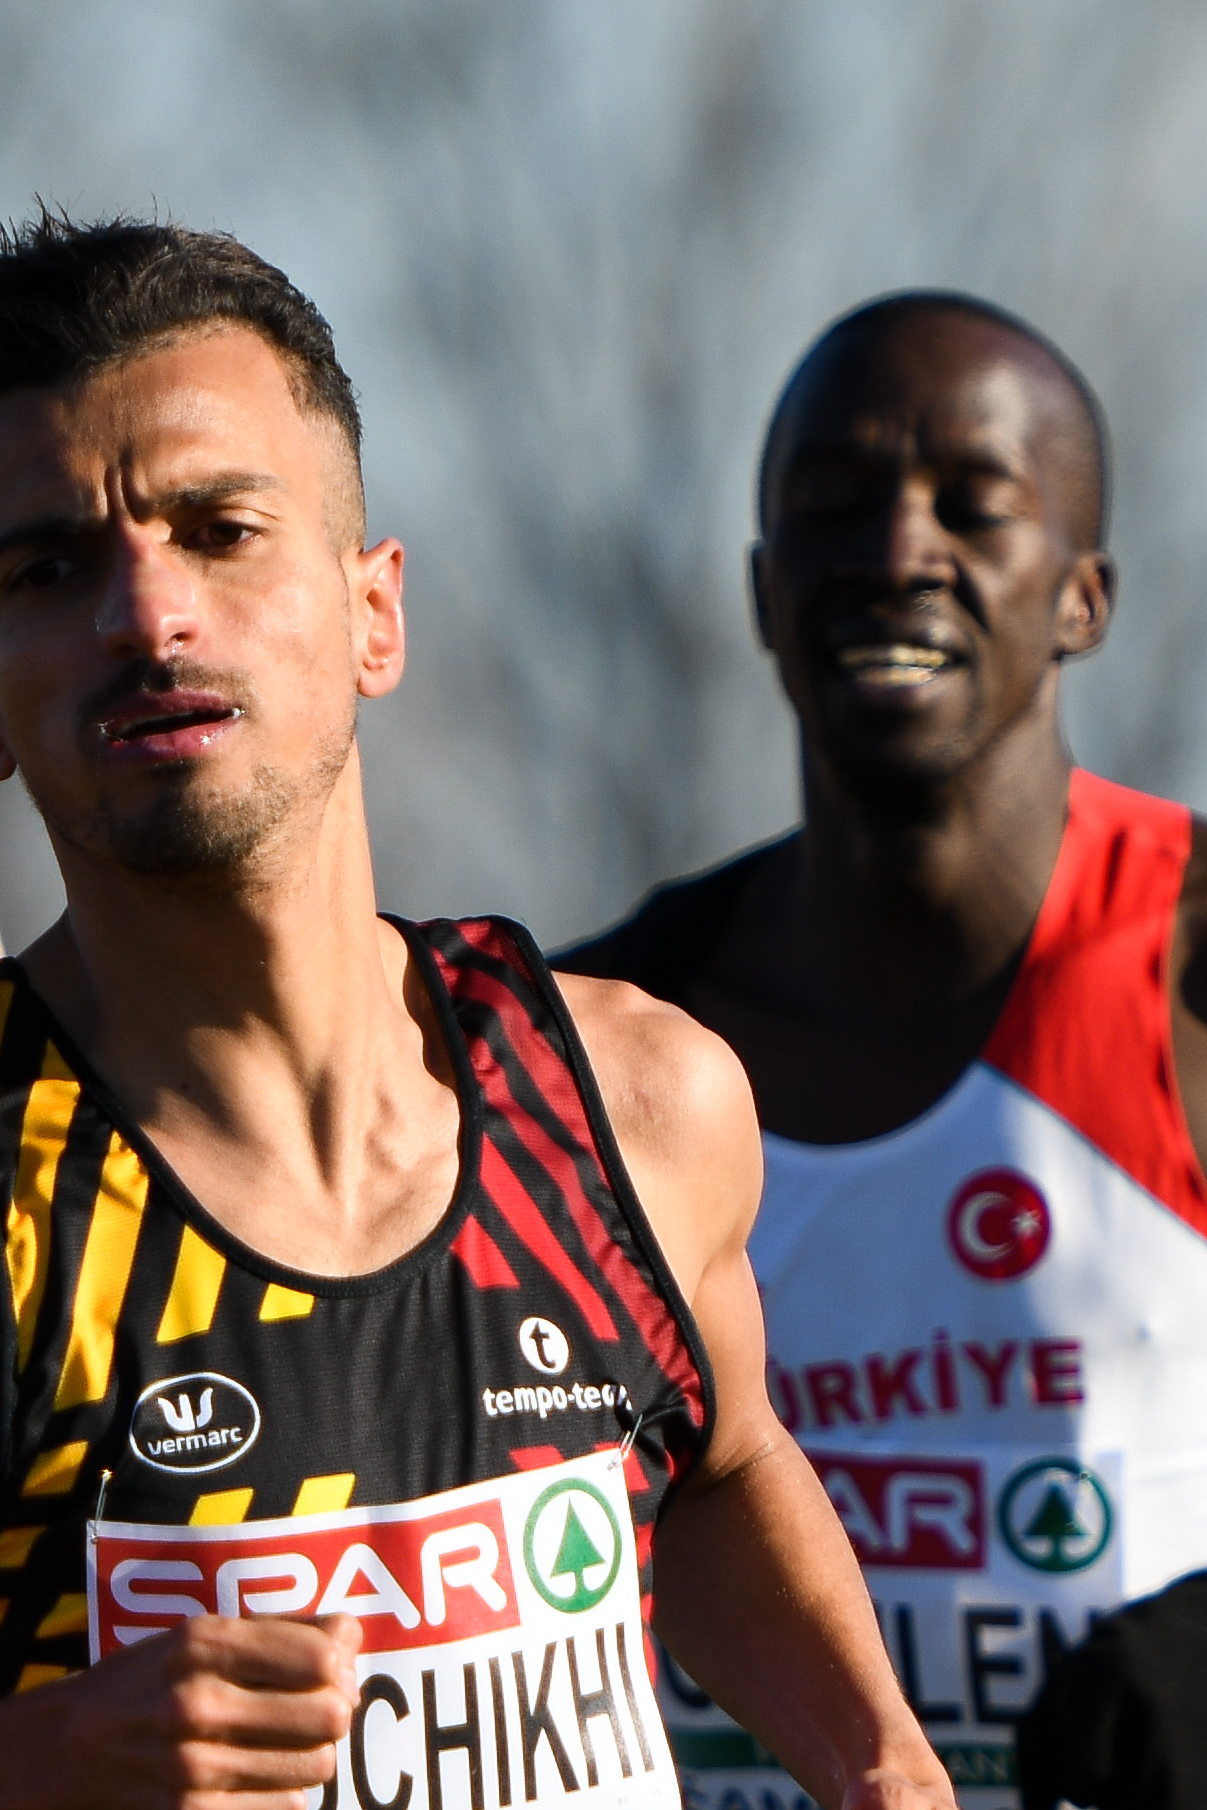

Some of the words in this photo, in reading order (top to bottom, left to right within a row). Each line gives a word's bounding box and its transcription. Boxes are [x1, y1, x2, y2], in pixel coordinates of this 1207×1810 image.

[767, 1326, 1085, 1432] RKİYE
[147, 1426, 243, 1455] vermarc
[823, 1468, 977, 1554] AR
[109, 1521, 509, 1645] SPAR
